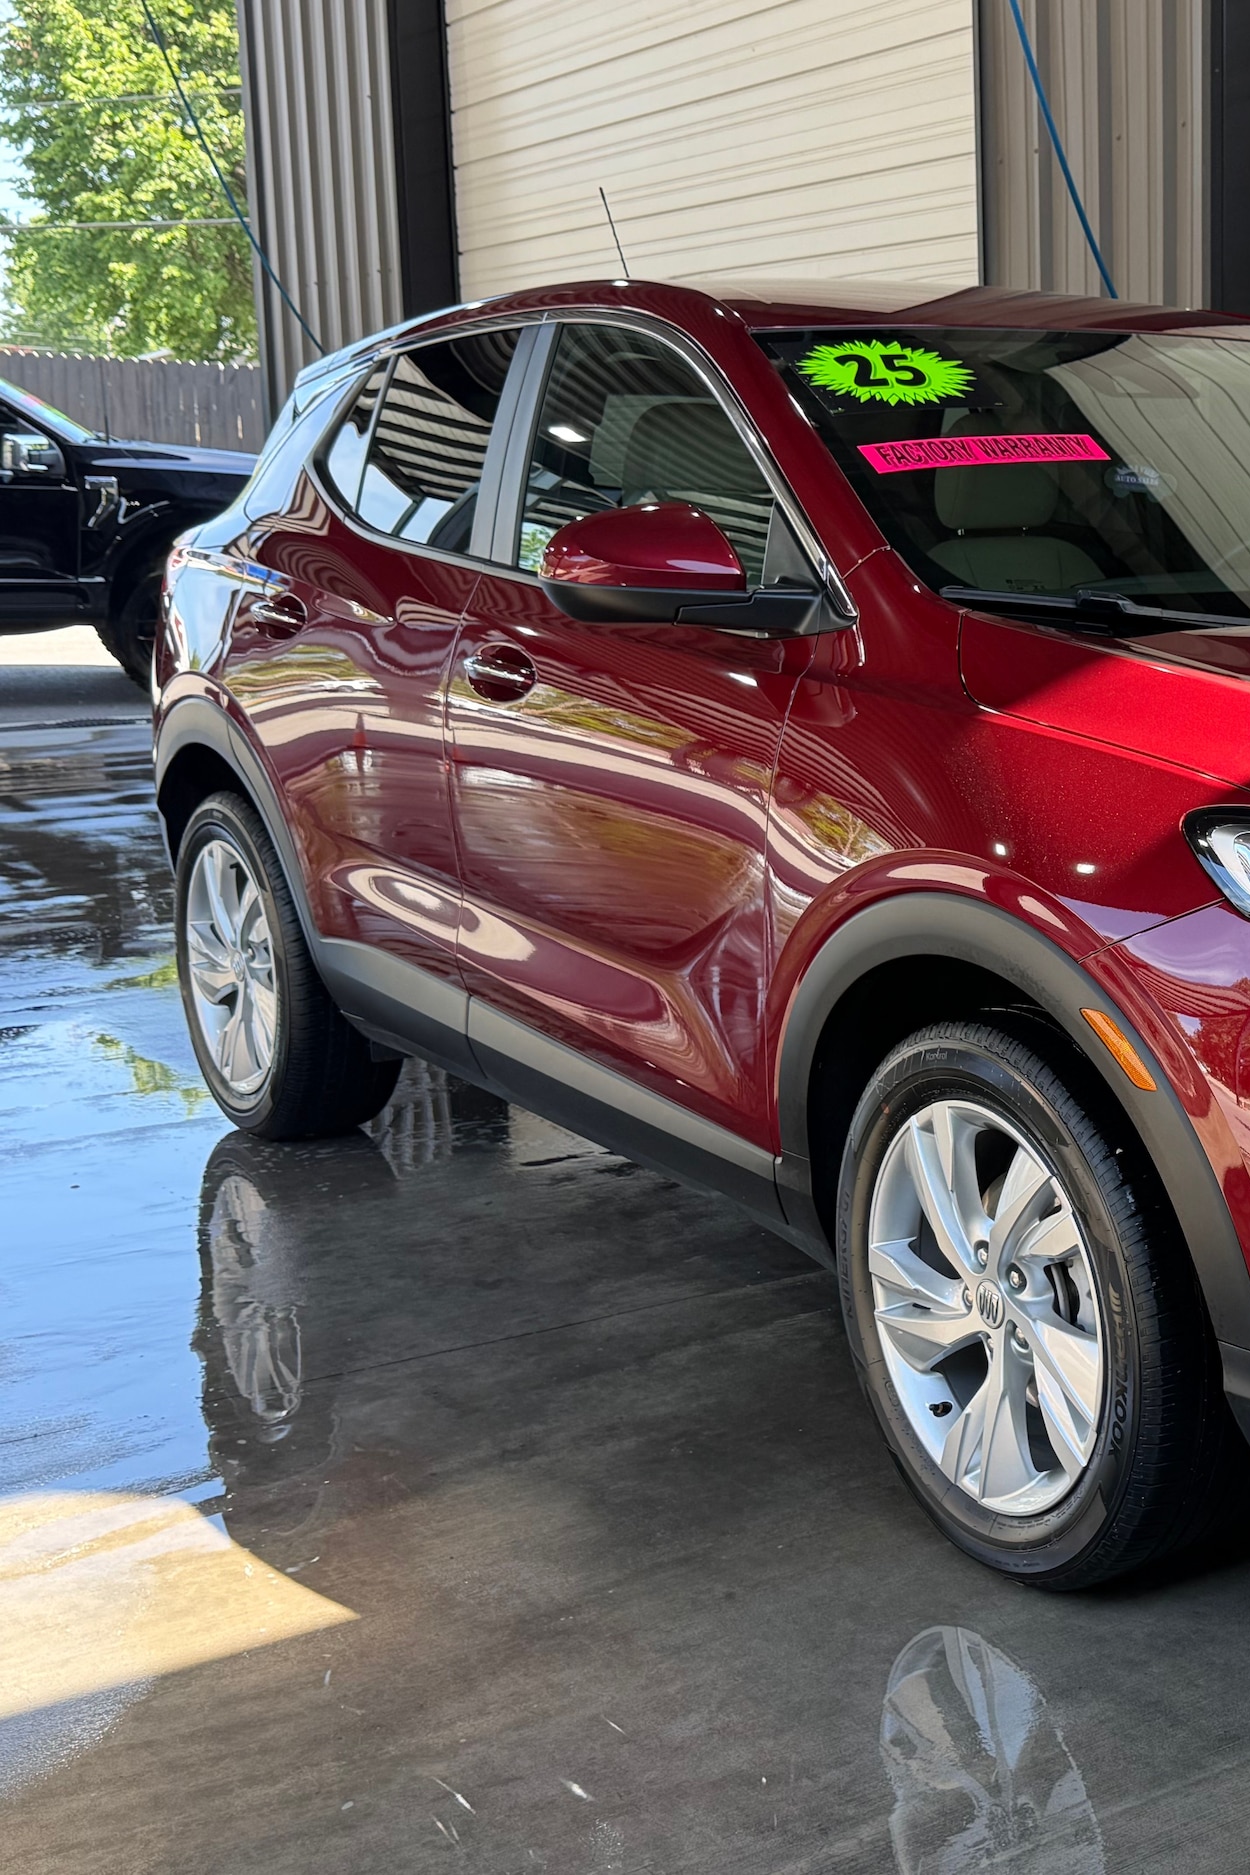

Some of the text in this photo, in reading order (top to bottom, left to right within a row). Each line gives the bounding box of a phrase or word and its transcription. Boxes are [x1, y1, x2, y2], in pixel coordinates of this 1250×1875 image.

[833, 353, 929, 388] 25
[875, 435, 1089, 466] FACTORY WARRANTY
[1115, 474, 1137, 484] AUTO
